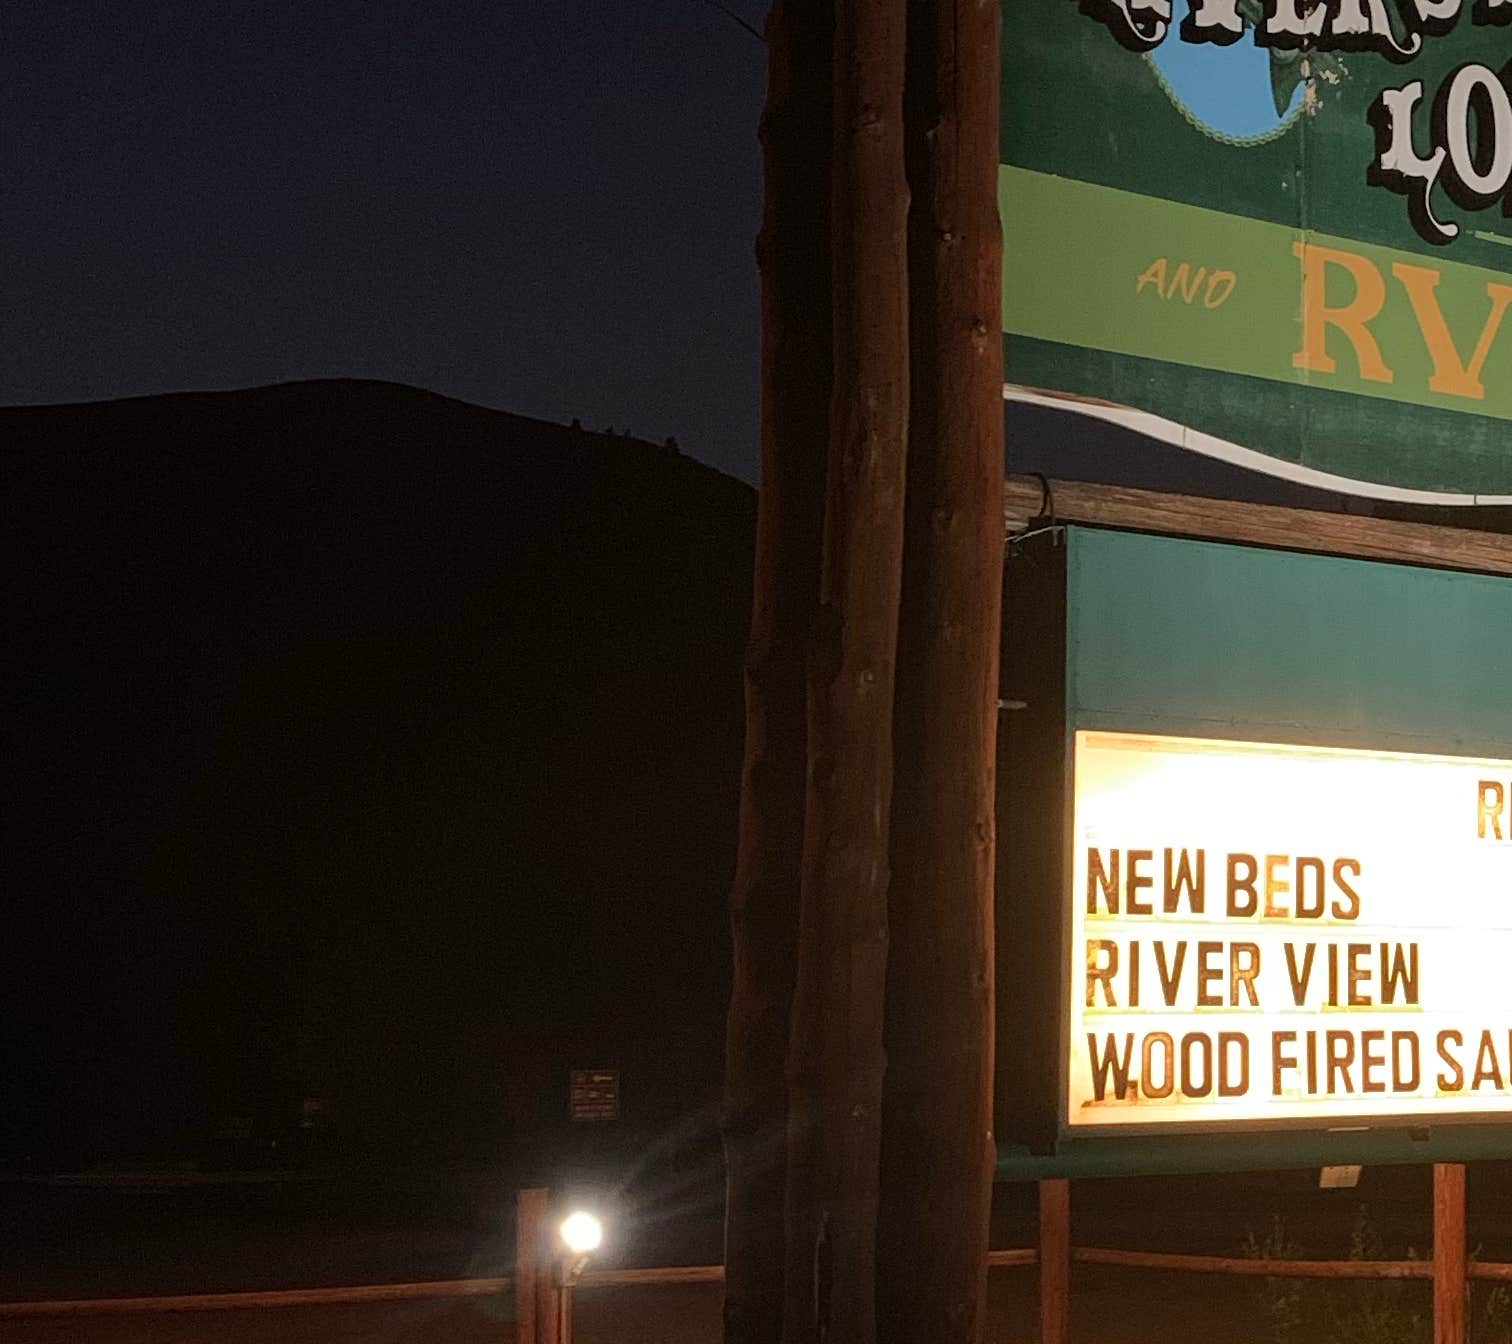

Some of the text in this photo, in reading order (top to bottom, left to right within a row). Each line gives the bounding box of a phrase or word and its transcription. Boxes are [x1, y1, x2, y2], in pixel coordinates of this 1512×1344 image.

[1137, 257, 1237, 309] AND
[1086, 847, 1362, 921] NEW BEDS
[1085, 939, 1420, 1008] RIVER VIEW
[1086, 1031, 1250, 1102] WOOD
[1271, 1029, 1420, 1096] FIRED
